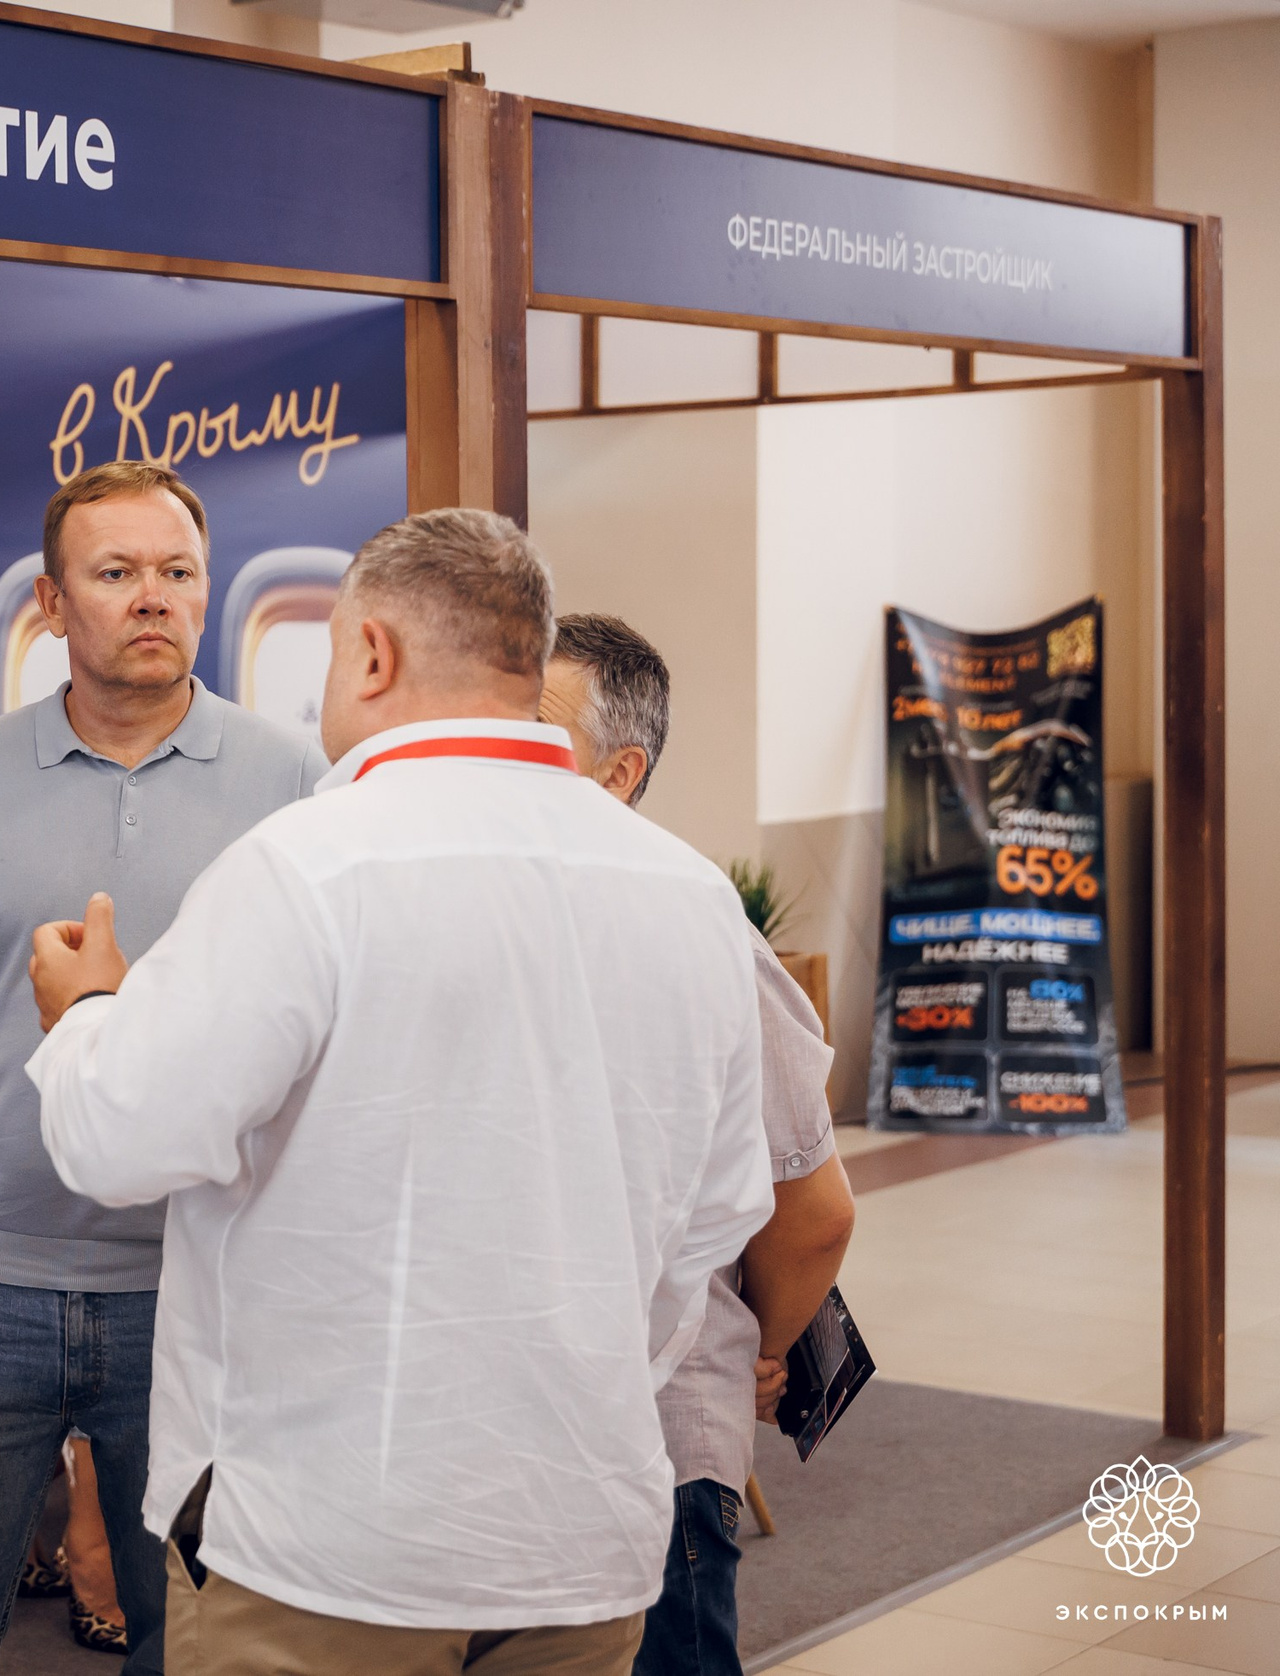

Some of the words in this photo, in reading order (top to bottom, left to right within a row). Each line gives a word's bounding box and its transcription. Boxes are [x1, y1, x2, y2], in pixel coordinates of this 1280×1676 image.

[727, 213, 907, 272] ФЕДЕРАЛЬНЫЙ
[913, 241, 1053, 293] ЗАСТРОЙЩИК
[113, 360, 360, 485] Крыму
[996, 844, 1098, 900] 65%
